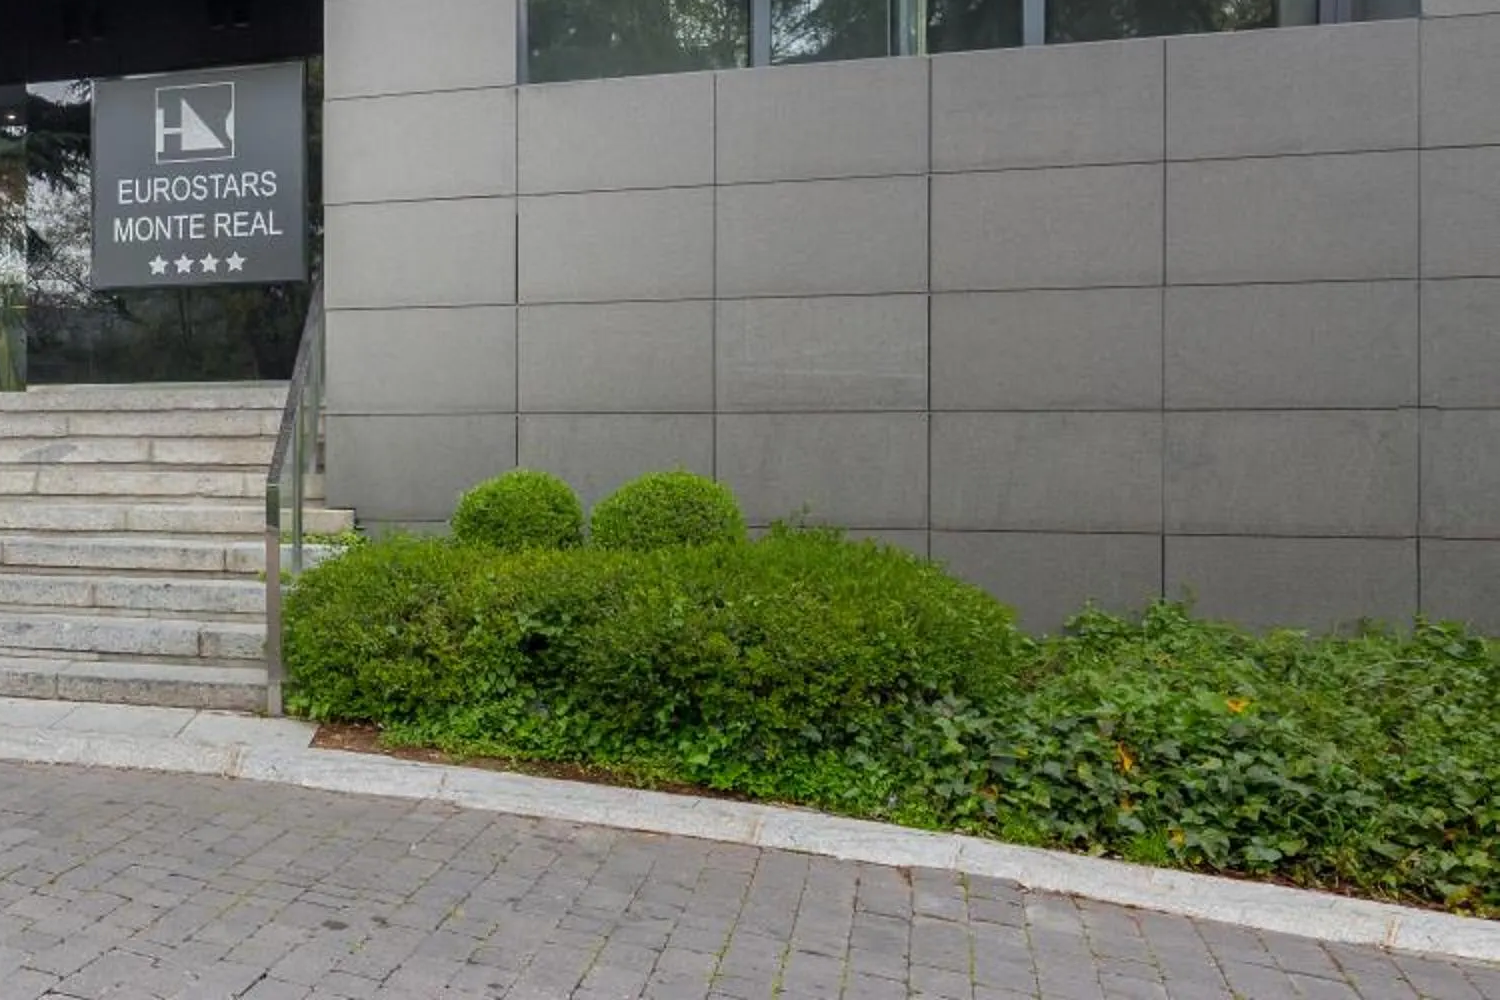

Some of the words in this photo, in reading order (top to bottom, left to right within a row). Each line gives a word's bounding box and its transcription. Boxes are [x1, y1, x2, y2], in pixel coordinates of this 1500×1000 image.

[117, 170, 278, 205] EUROSTARS
[113, 213, 206, 243] MONTE
[213, 209, 284, 239] REAL
